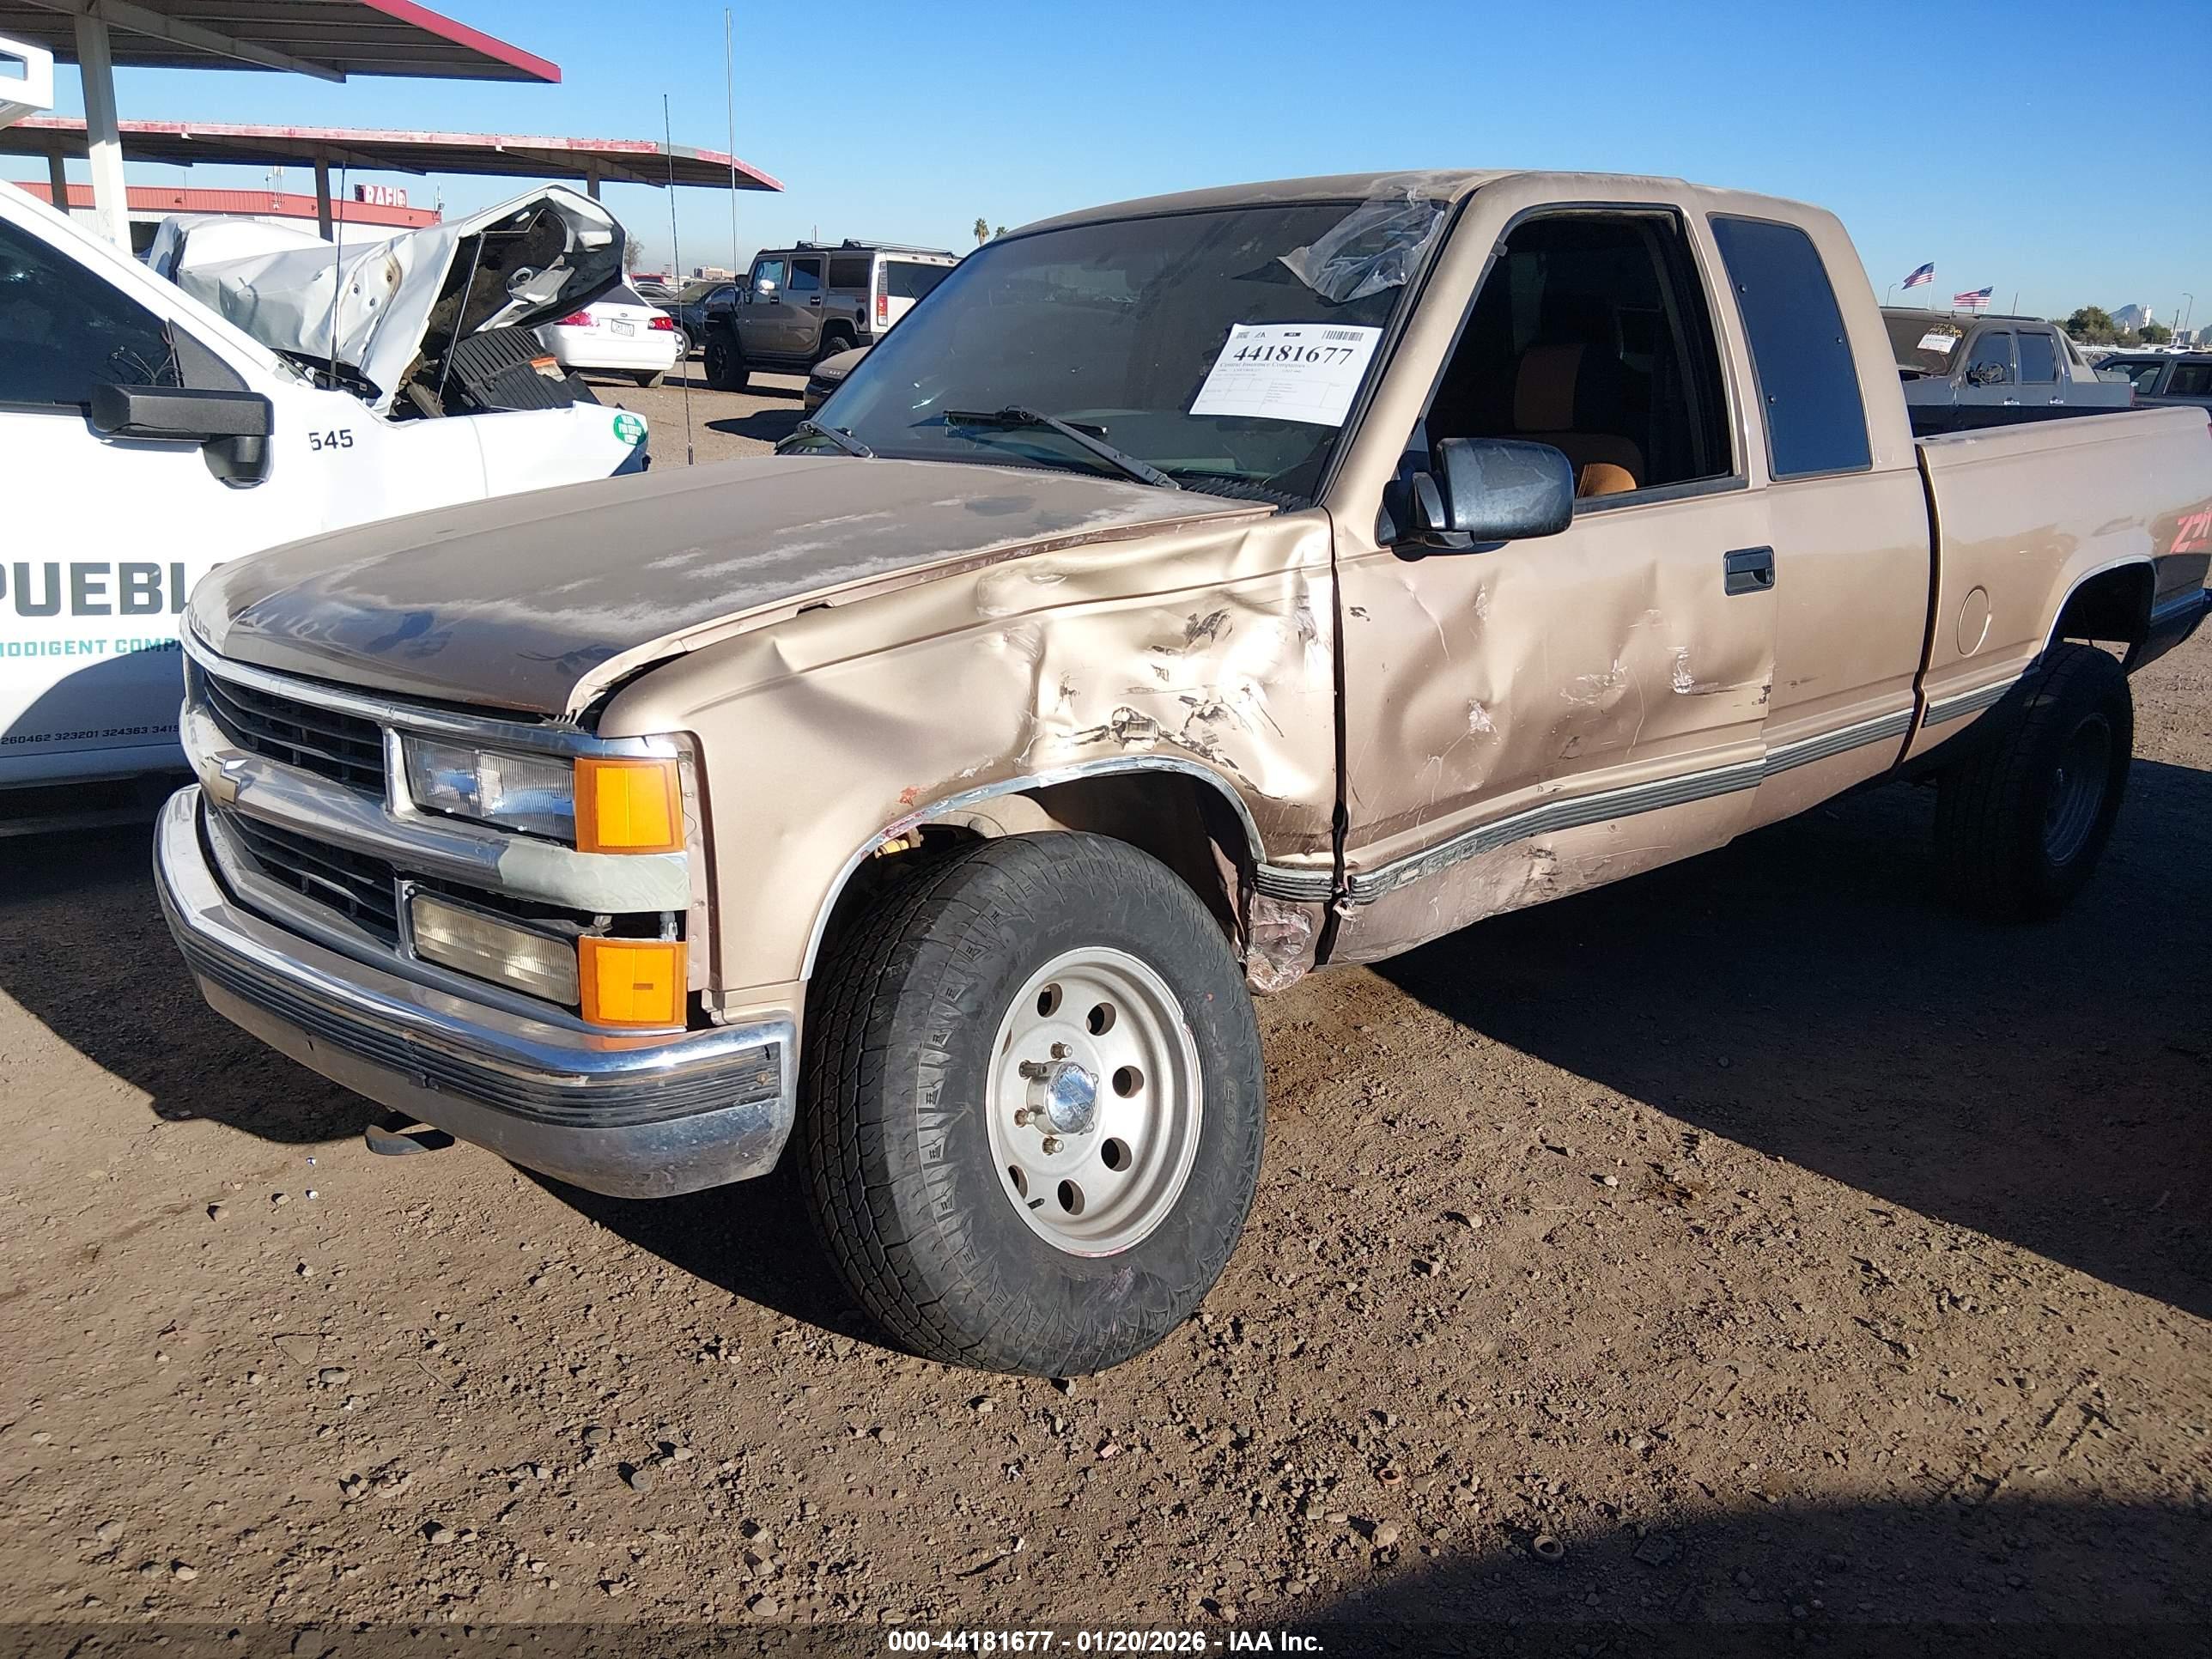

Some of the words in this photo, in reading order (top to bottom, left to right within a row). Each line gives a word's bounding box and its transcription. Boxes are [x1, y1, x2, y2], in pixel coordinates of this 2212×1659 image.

[1233, 344, 1354, 366] 44181677
[308, 428, 354, 452] 545
[54, 730, 100, 741] 323201
